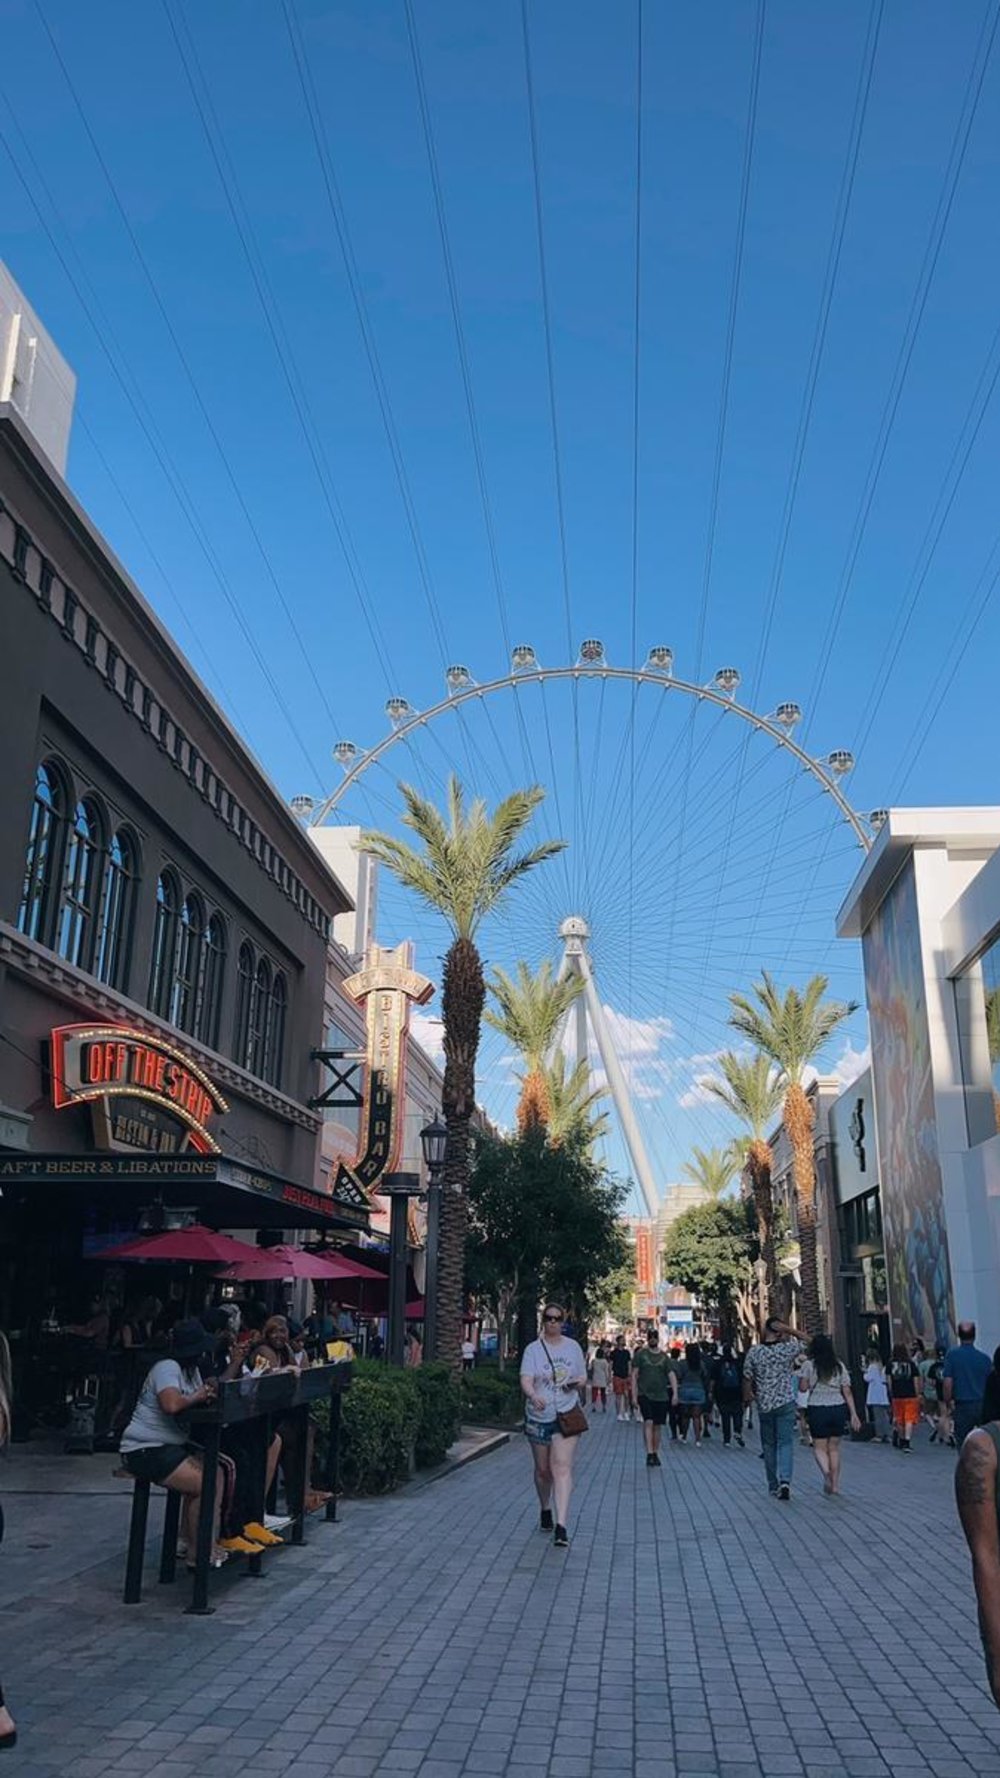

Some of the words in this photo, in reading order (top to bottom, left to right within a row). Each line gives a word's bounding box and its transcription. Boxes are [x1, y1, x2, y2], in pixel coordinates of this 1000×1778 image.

[88, 1043, 127, 1083] OFF
[134, 1045, 167, 1093] THE
[168, 1064, 213, 1126] STRIP
[46, 1161, 96, 1175] BEER
[99, 1161, 114, 1174] &
[117, 1161, 217, 1175] LIBATIONS
